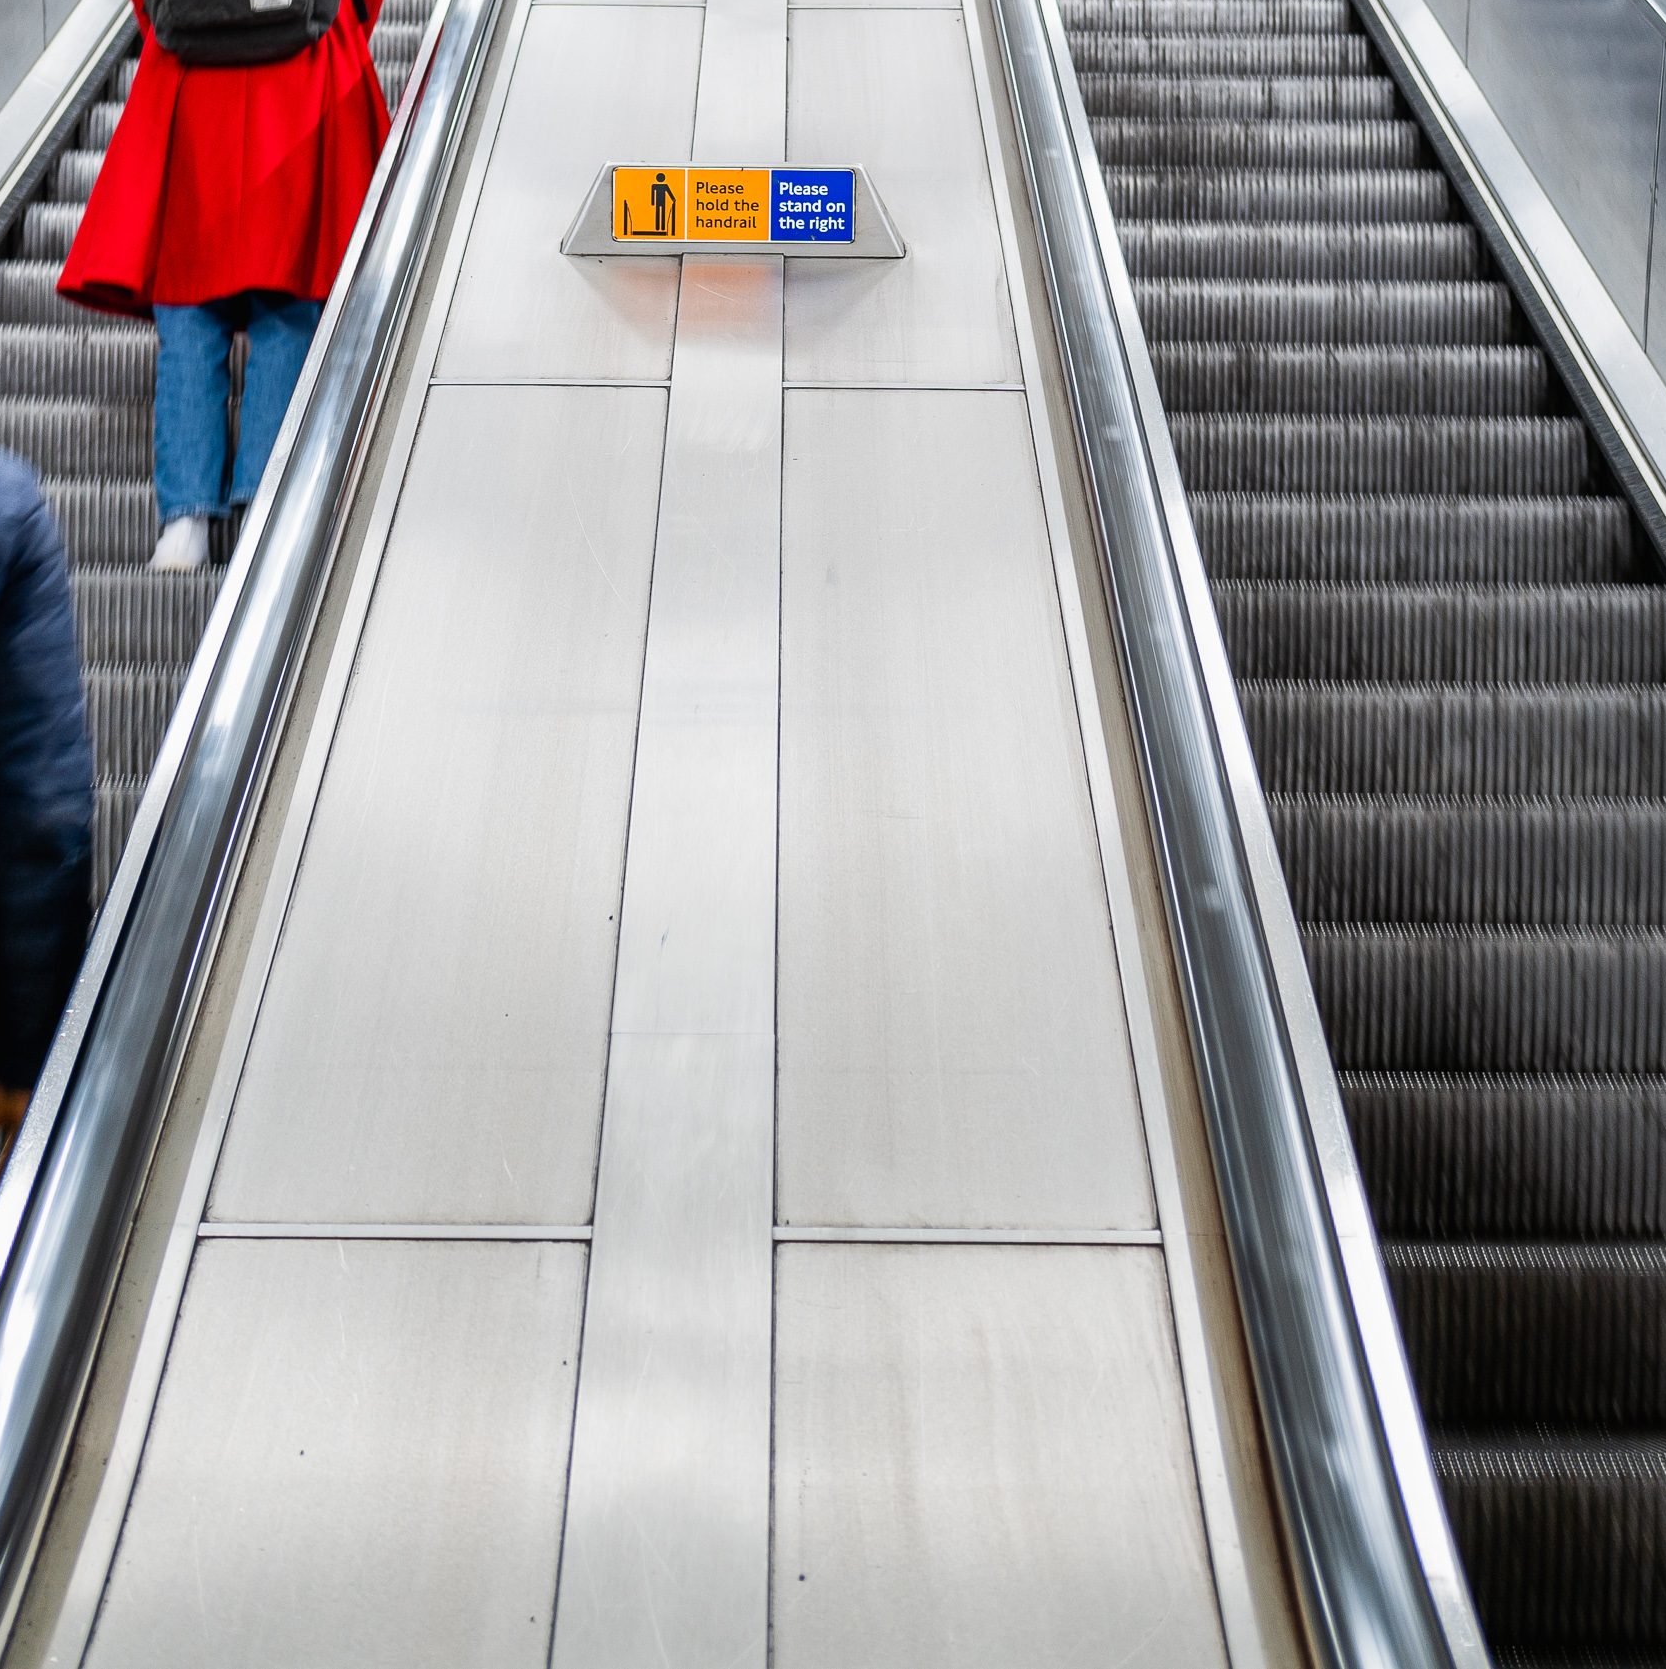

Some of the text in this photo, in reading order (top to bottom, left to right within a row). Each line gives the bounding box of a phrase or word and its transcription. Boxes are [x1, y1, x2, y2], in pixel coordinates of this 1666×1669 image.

[696, 181, 744, 194] Please
[779, 182, 829, 196] Please
[696, 199, 760, 212] hold the
[779, 199, 846, 213] stand on
[696, 216, 757, 229] handrail
[779, 217, 845, 233] the right
